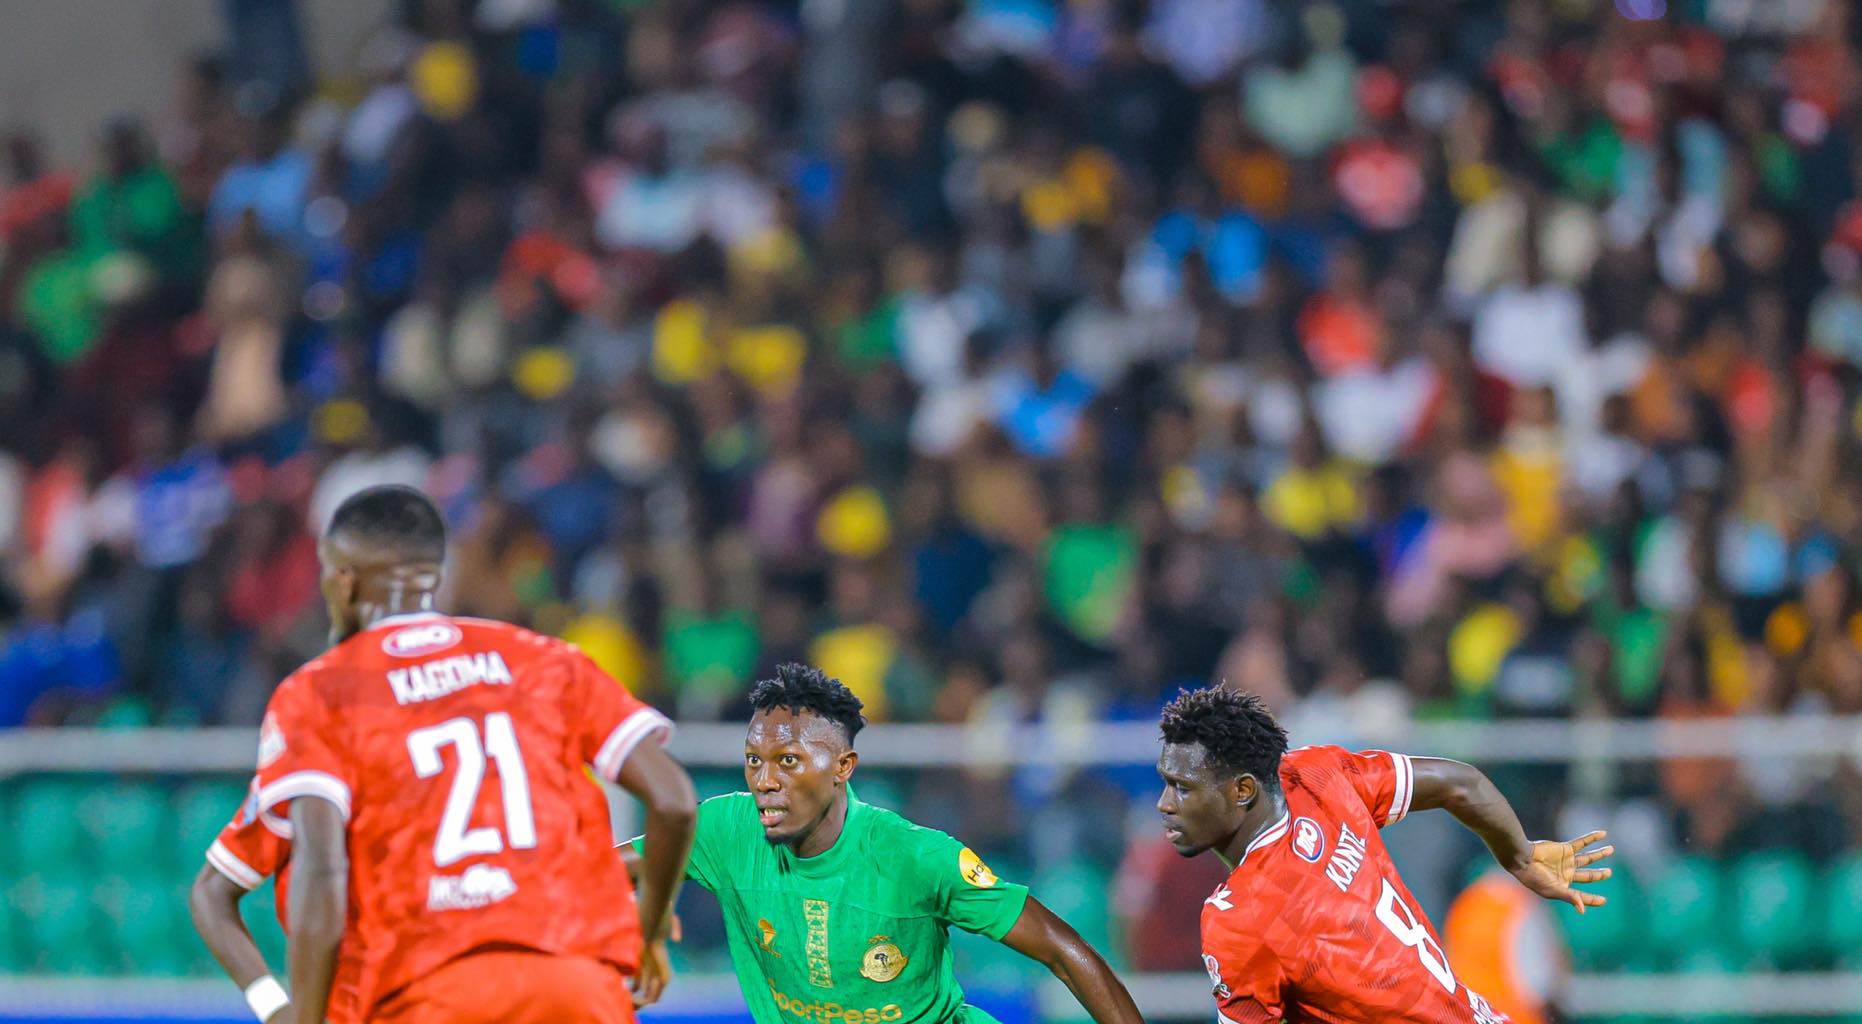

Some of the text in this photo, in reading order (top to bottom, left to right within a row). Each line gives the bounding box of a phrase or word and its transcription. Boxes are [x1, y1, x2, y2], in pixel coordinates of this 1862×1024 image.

[386, 650, 513, 706] KAGOMA
[406, 711, 538, 868] 21
[1374, 876, 1458, 995] 8
